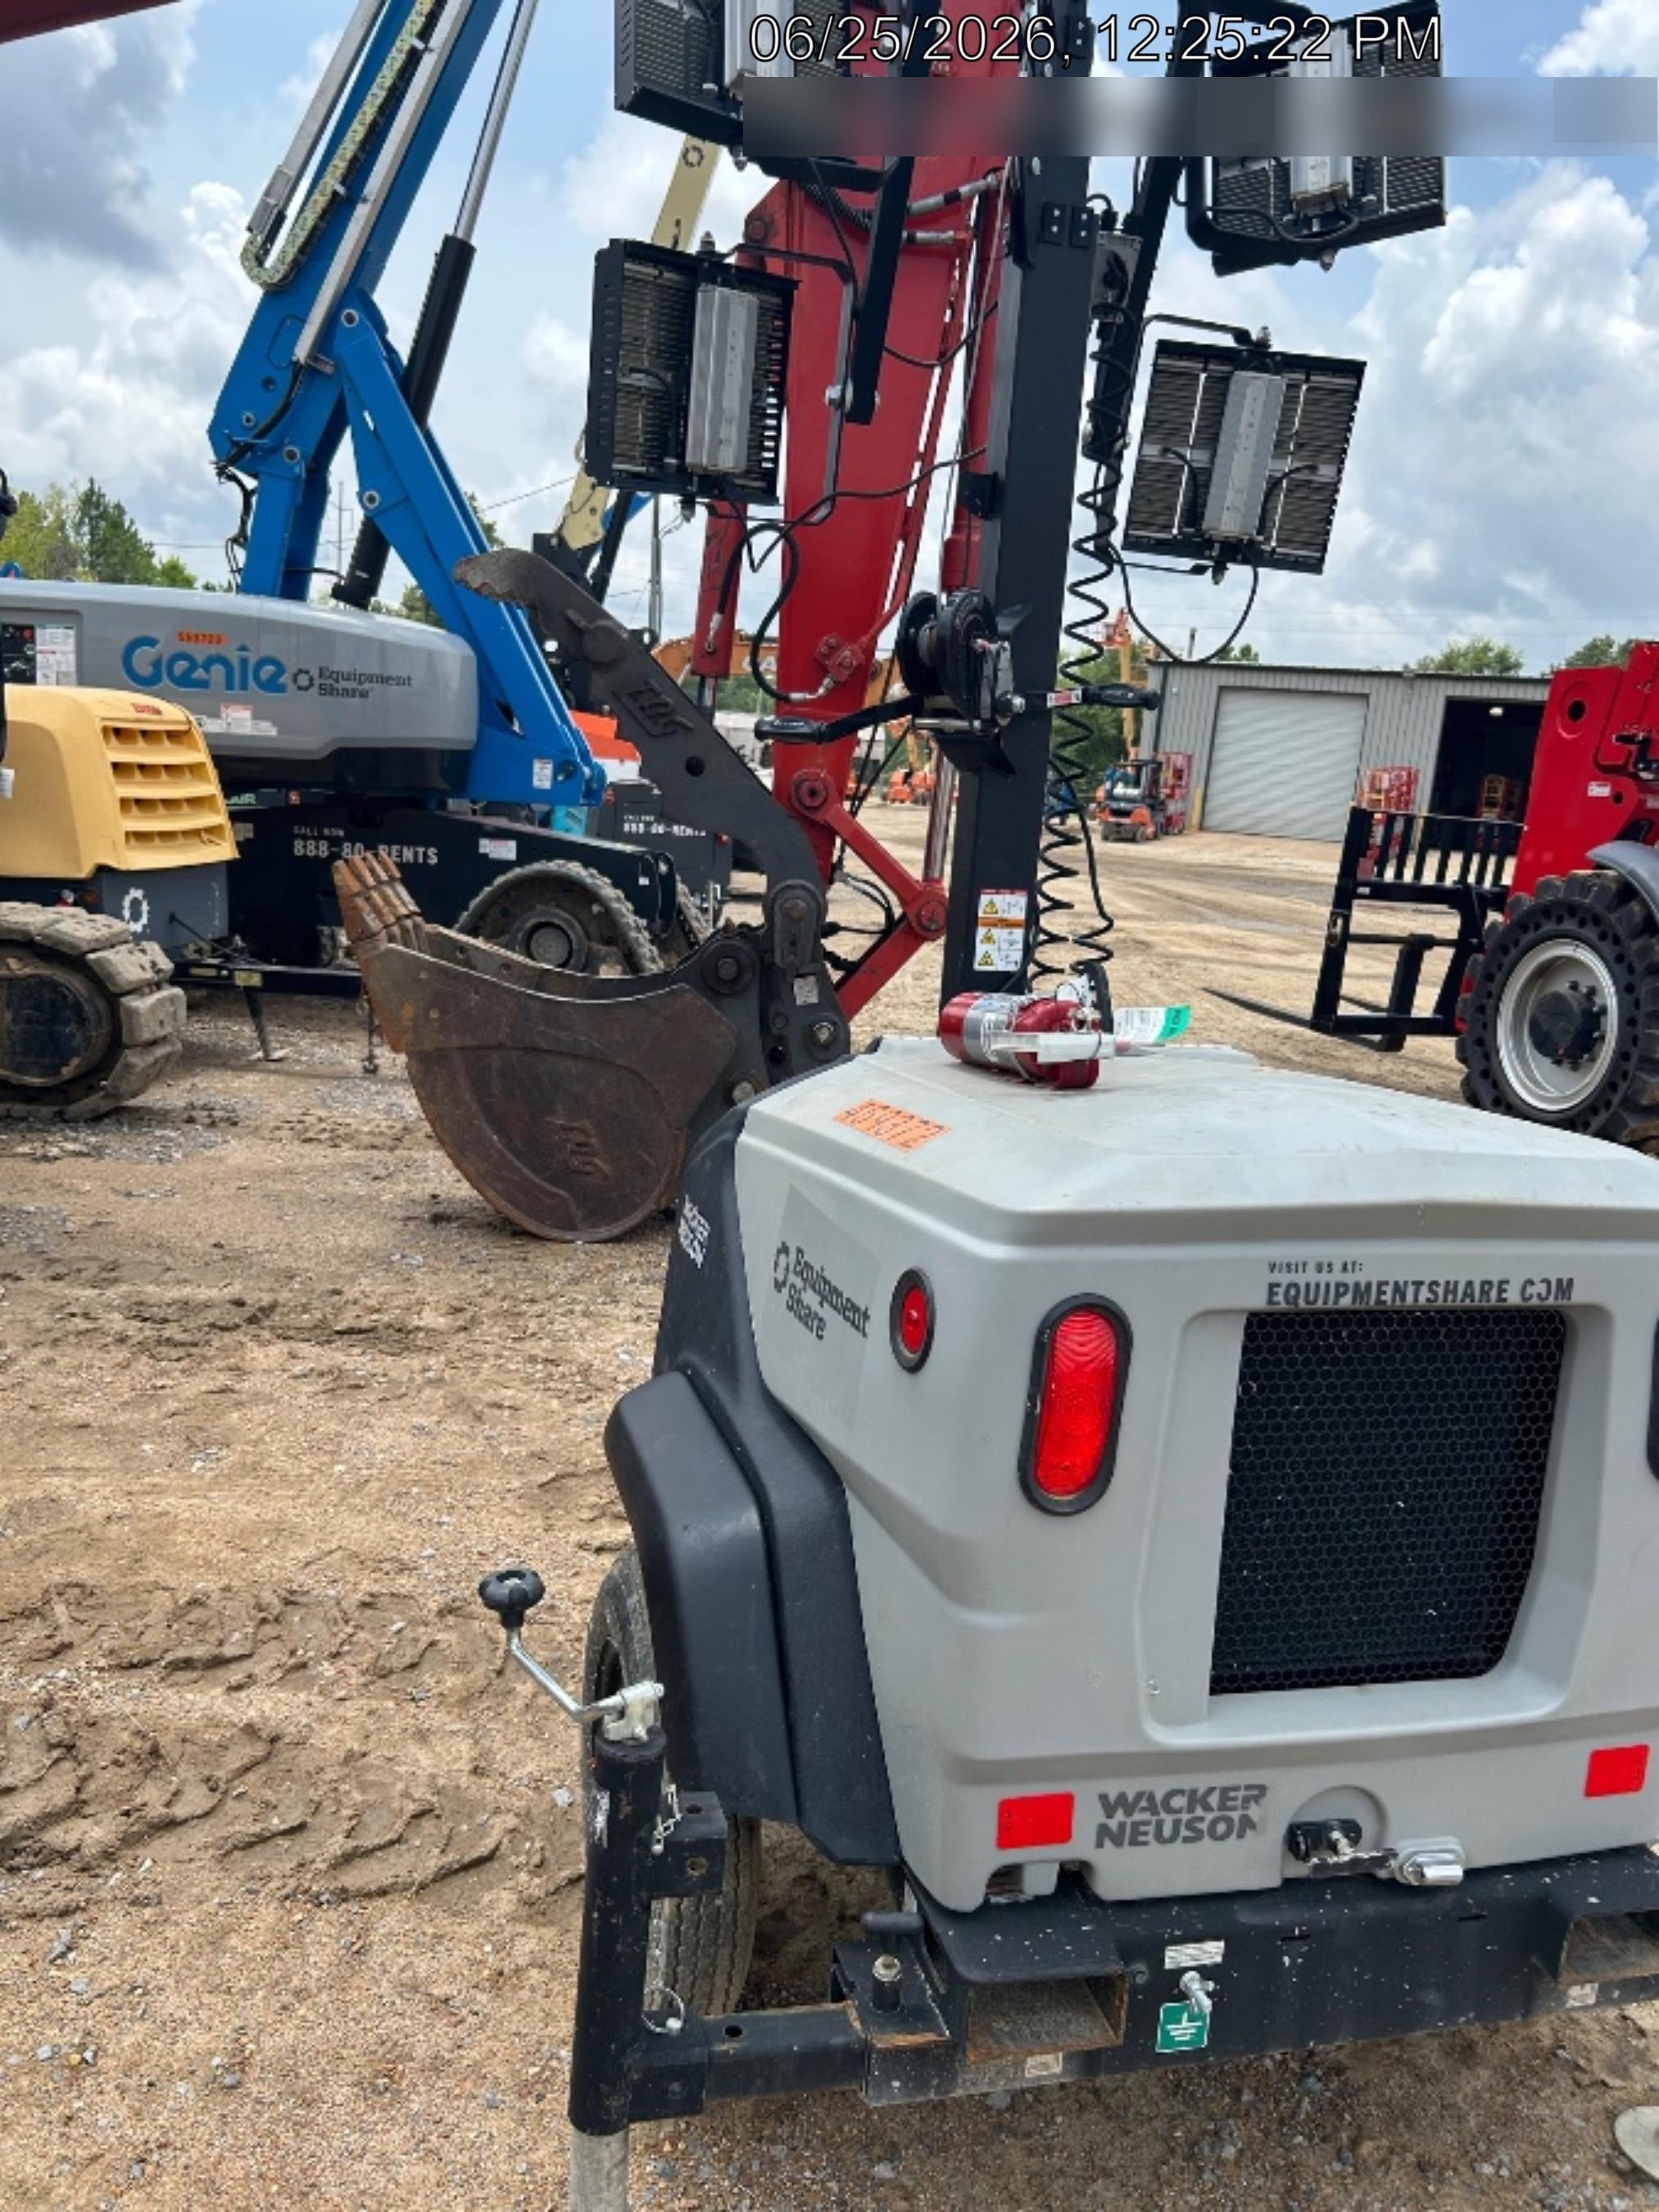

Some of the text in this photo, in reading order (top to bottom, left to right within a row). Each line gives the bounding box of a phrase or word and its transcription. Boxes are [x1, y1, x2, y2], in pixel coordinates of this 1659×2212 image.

[121, 636, 287, 694] Genie
[318, 666, 413, 687] Equipment
[318, 683, 369, 699] Share
[293, 826, 319, 836] CALL
[1268, 1260, 1363, 1274] VISIT US AT:
[793, 1245, 870, 1339] Equipment
[786, 1282, 826, 1340] Share
[1098, 1784, 1268, 1820] WACKER
[1095, 1813, 1258, 1849] NEUSON
